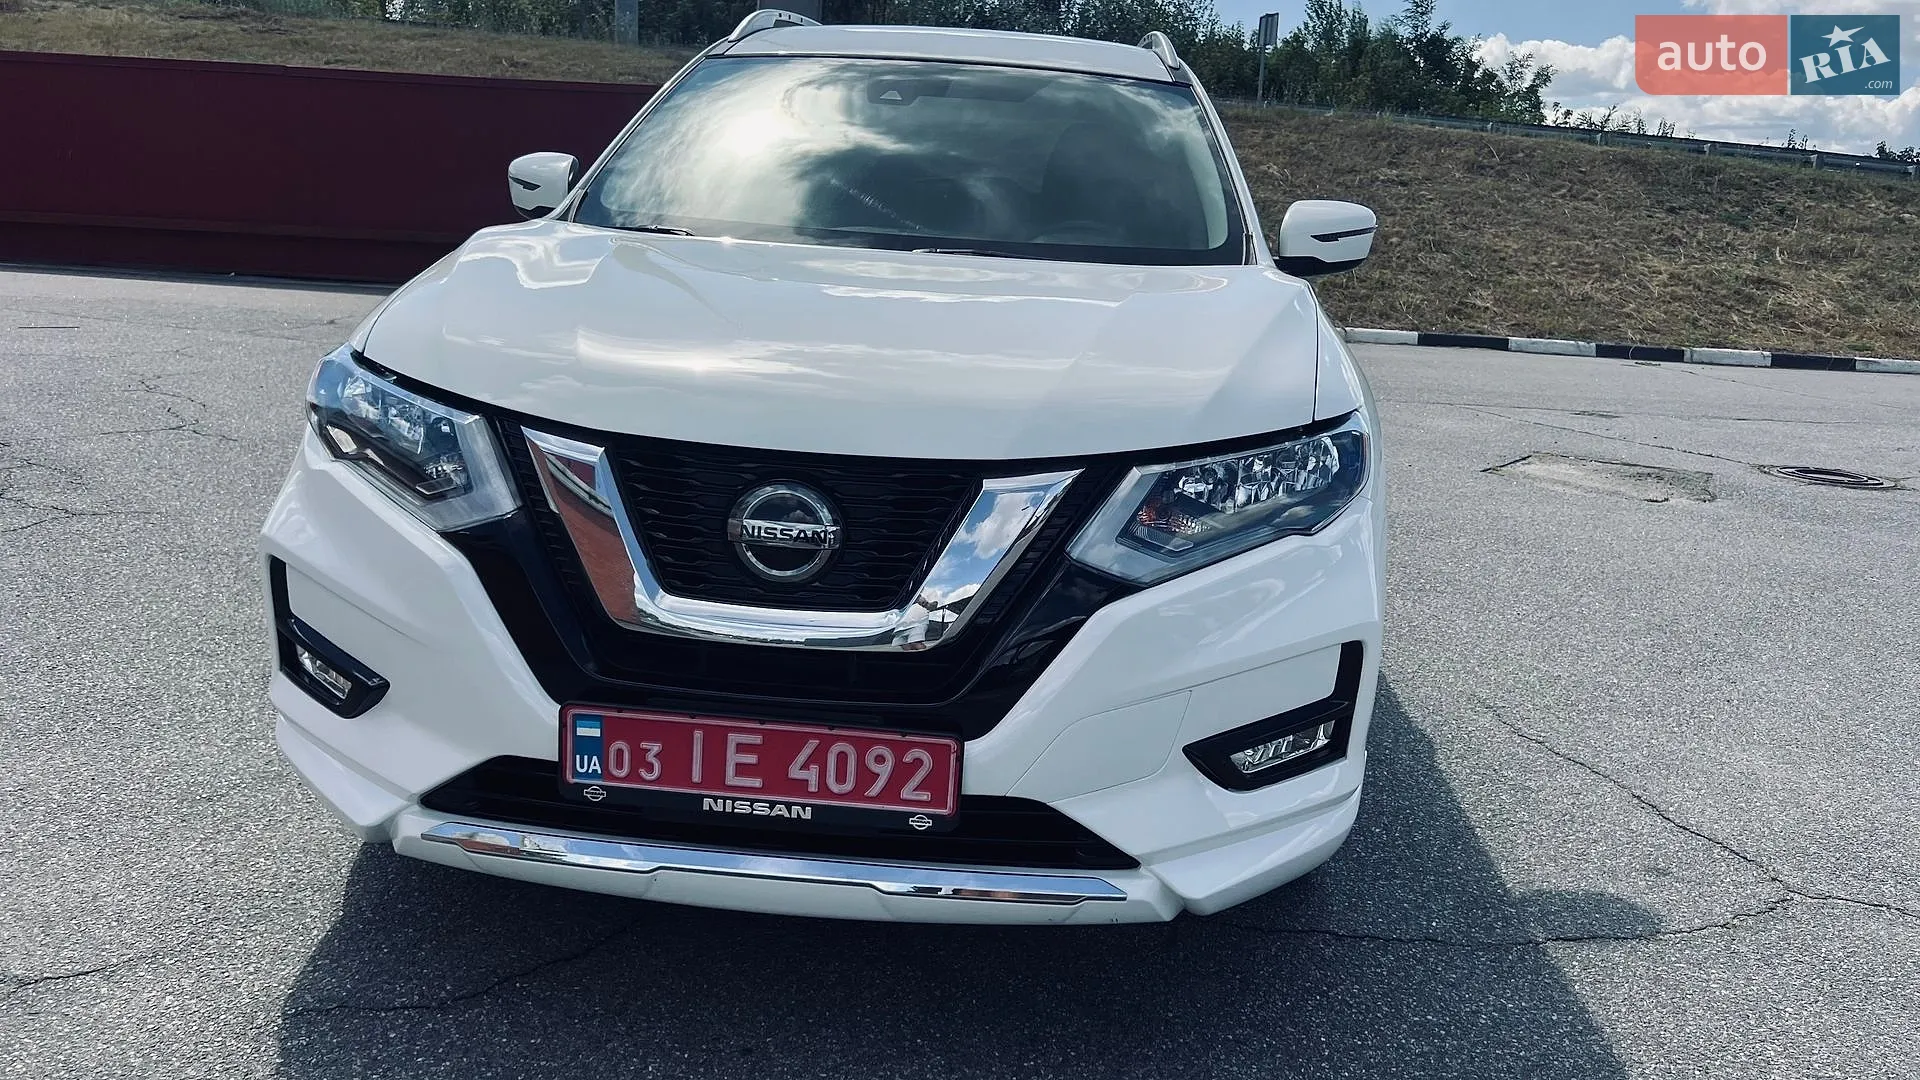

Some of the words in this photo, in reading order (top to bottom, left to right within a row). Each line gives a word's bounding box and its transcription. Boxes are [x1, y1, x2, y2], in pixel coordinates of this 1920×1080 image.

[740, 524, 828, 545] NISSAN
[576, 754, 602, 775] UA
[608, 741, 663, 782] 03
[692, 729, 764, 789] IE
[788, 739, 933, 802] 4092
[702, 798, 812, 820] NISSAN
